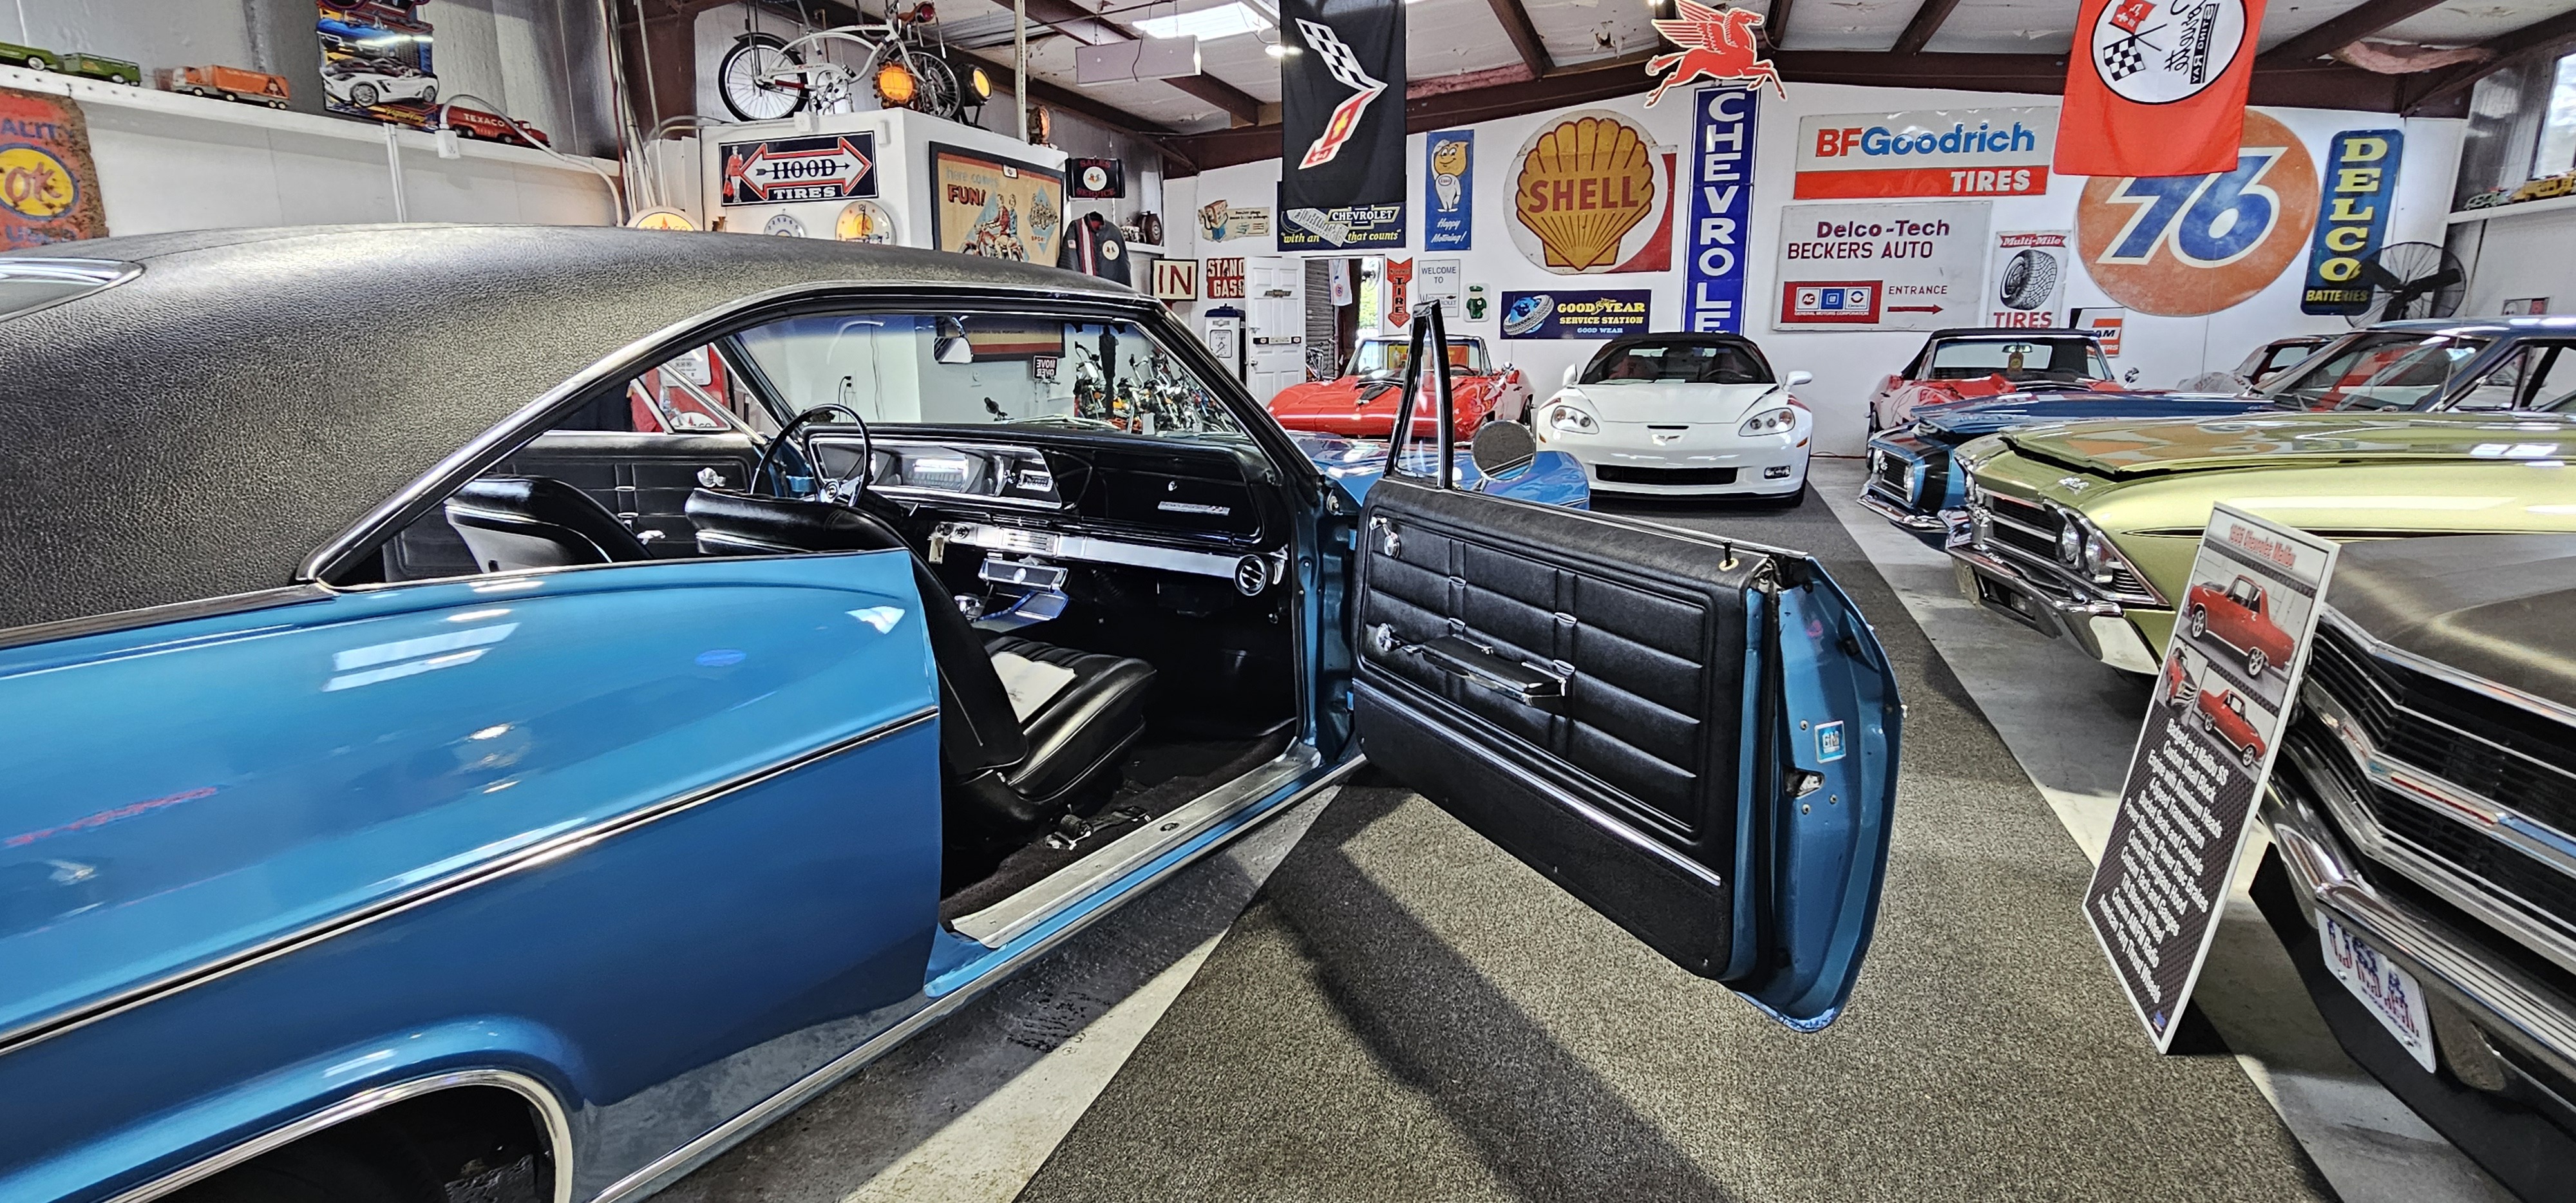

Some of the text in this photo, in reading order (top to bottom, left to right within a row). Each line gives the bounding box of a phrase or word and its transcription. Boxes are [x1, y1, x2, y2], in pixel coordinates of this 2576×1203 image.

[463, 113, 506, 128] TEXACO
[1815, 122, 2035, 157] BFGoodrich
[773, 158, 836, 179] HOOD
[1079, 160, 1111, 169] SALES
[5, 162, 62, 202] OK
[773, 186, 836, 200] TIRES
[947, 184, 987, 206] FUN!
[1076, 187, 1115, 197] SERVICE
[1528, 176, 1640, 213] SHELL
[1950, 170, 2031, 193] TIRES
[1332, 211, 1393, 221] CHEVROLET
[1437, 218, 1461, 231] Happy
[1694, 92, 1746, 334] CHEVROLE
[2094, 147, 2289, 270] 76
[2319, 137, 2388, 281] DELCO
[1347, 231, 1367, 241] that
[1788, 241, 1933, 259] BECKERS AUTO
[2003, 236, 2061, 246] Multi-Mile
[1159, 265, 1191, 296] IN
[1395, 277, 1404, 314] TIRE
[1888, 285, 1948, 295] ENTRANCE
[2306, 290, 2369, 302] BATTERIES
[1605, 316, 1643, 325] STATION
[1993, 312, 2053, 328] TIRES
[1822, 730, 1840, 748] GM
[2166, 718, 2229, 786] Badged as a Malibu SS
[2163, 740, 2216, 803] Custom Small Block
[2148, 749, 2222, 838] Engine with Aluminum Heads
[2139, 790, 2204, 876] Bucket Seats and Console
[2168, 797, 2205, 849] Transmission
[2125, 797, 2140, 823] Power
[2157, 840, 2176, 869] Power
[2173, 860, 2188, 886] Disc
[2185, 876, 2209, 913] Brakes
[2128, 829, 2188, 915] Custom Fiberglass Hood
[2121, 846, 2180, 936] Custom Tach and Gauges
[2121, 872, 2165, 944] Tilt Steering Wheel
[2112, 887, 2130, 922] Custom
[2142, 936, 2159, 968] Radio
[2098, 894, 2161, 1003] American Torq Thrust Wheels
